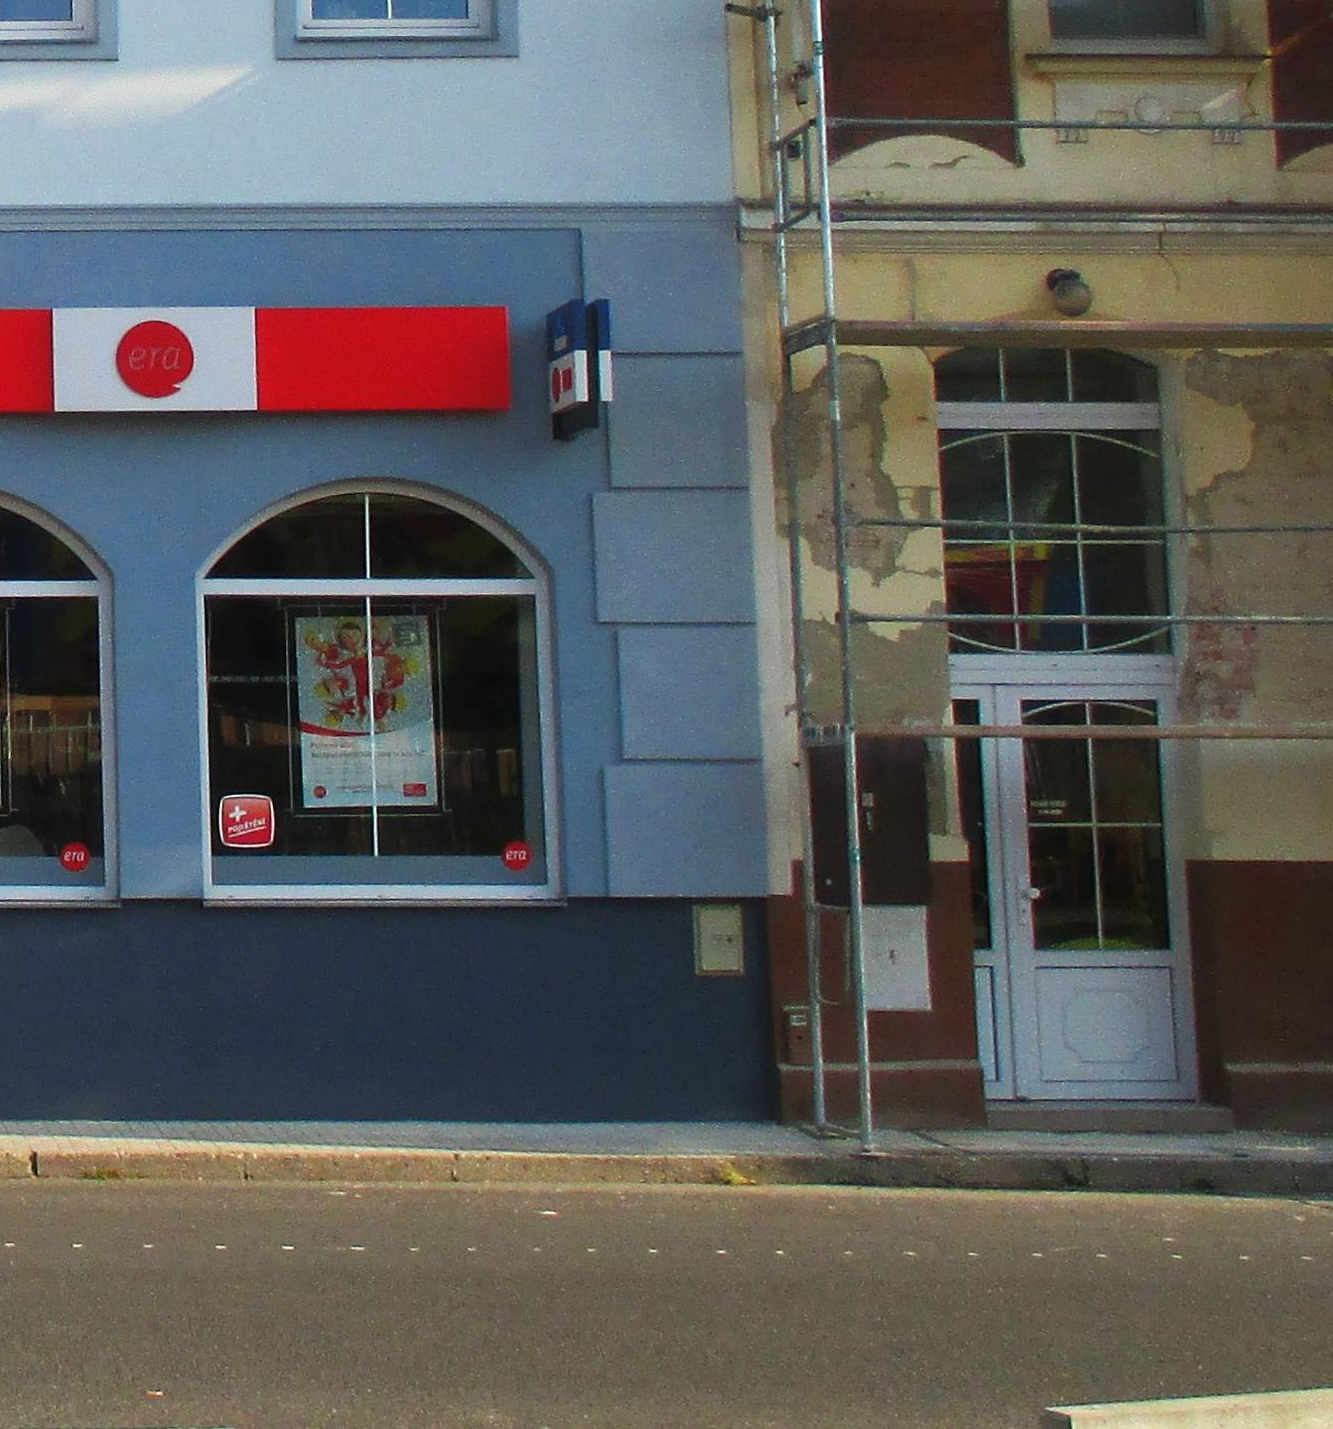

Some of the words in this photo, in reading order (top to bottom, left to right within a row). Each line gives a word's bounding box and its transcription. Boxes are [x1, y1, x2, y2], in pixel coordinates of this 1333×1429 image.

[127, 344, 182, 371] era
[63, 850, 85, 861] era
[505, 850, 527, 861] era
